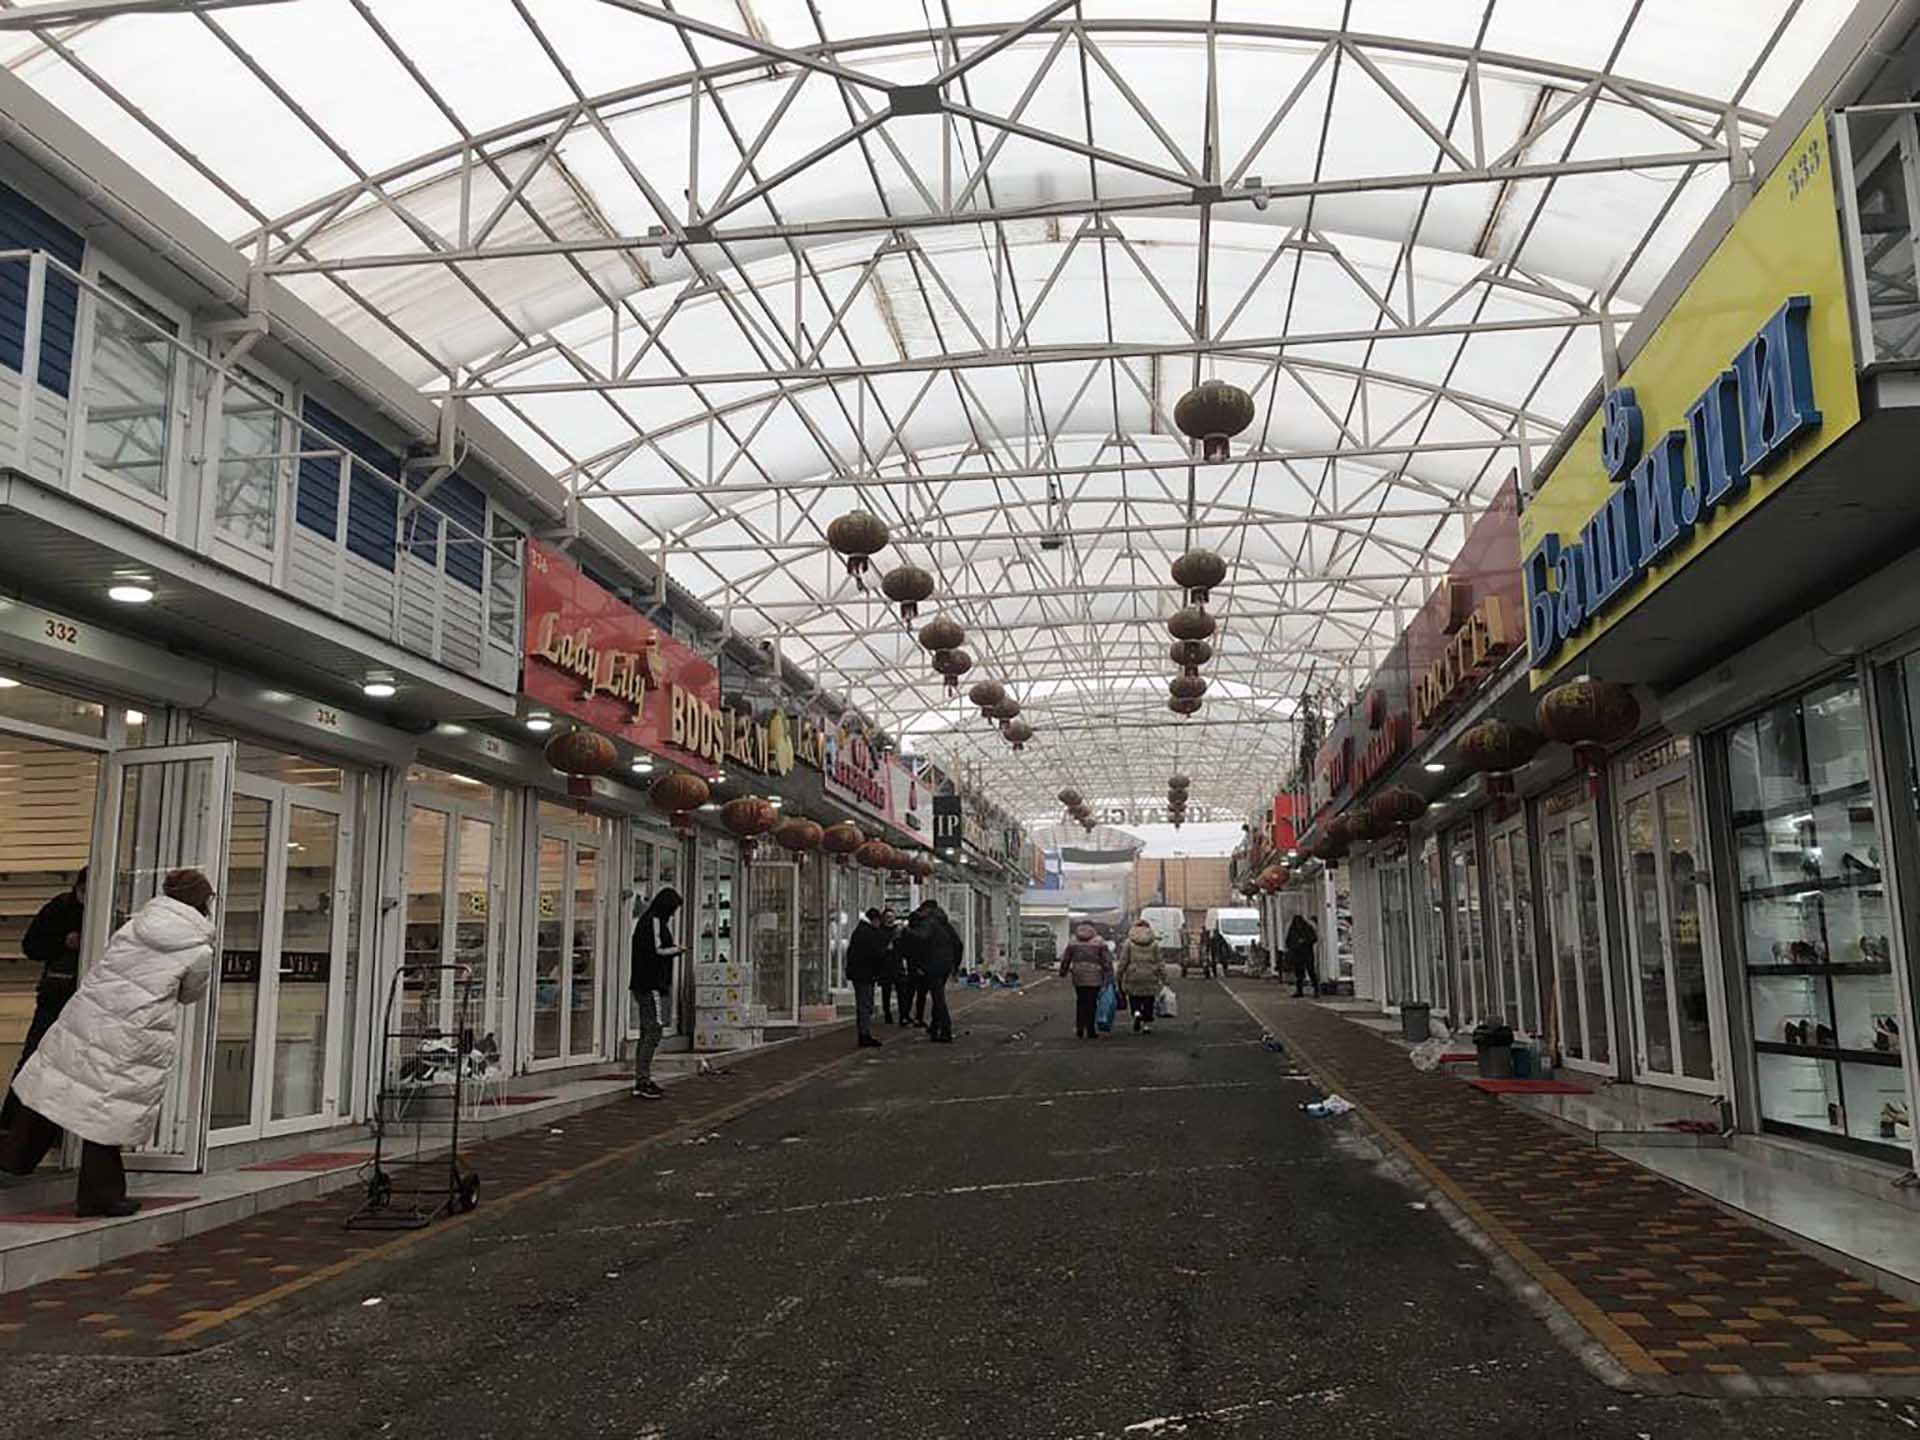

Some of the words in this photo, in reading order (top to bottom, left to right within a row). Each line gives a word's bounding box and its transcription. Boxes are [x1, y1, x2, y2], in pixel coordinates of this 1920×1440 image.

[1788, 139, 1821, 202] 333
[1523, 295, 1822, 671] Башили
[44, 618, 79, 645] 332
[530, 611, 601, 700] Lady
[317, 707, 338, 726] 334
